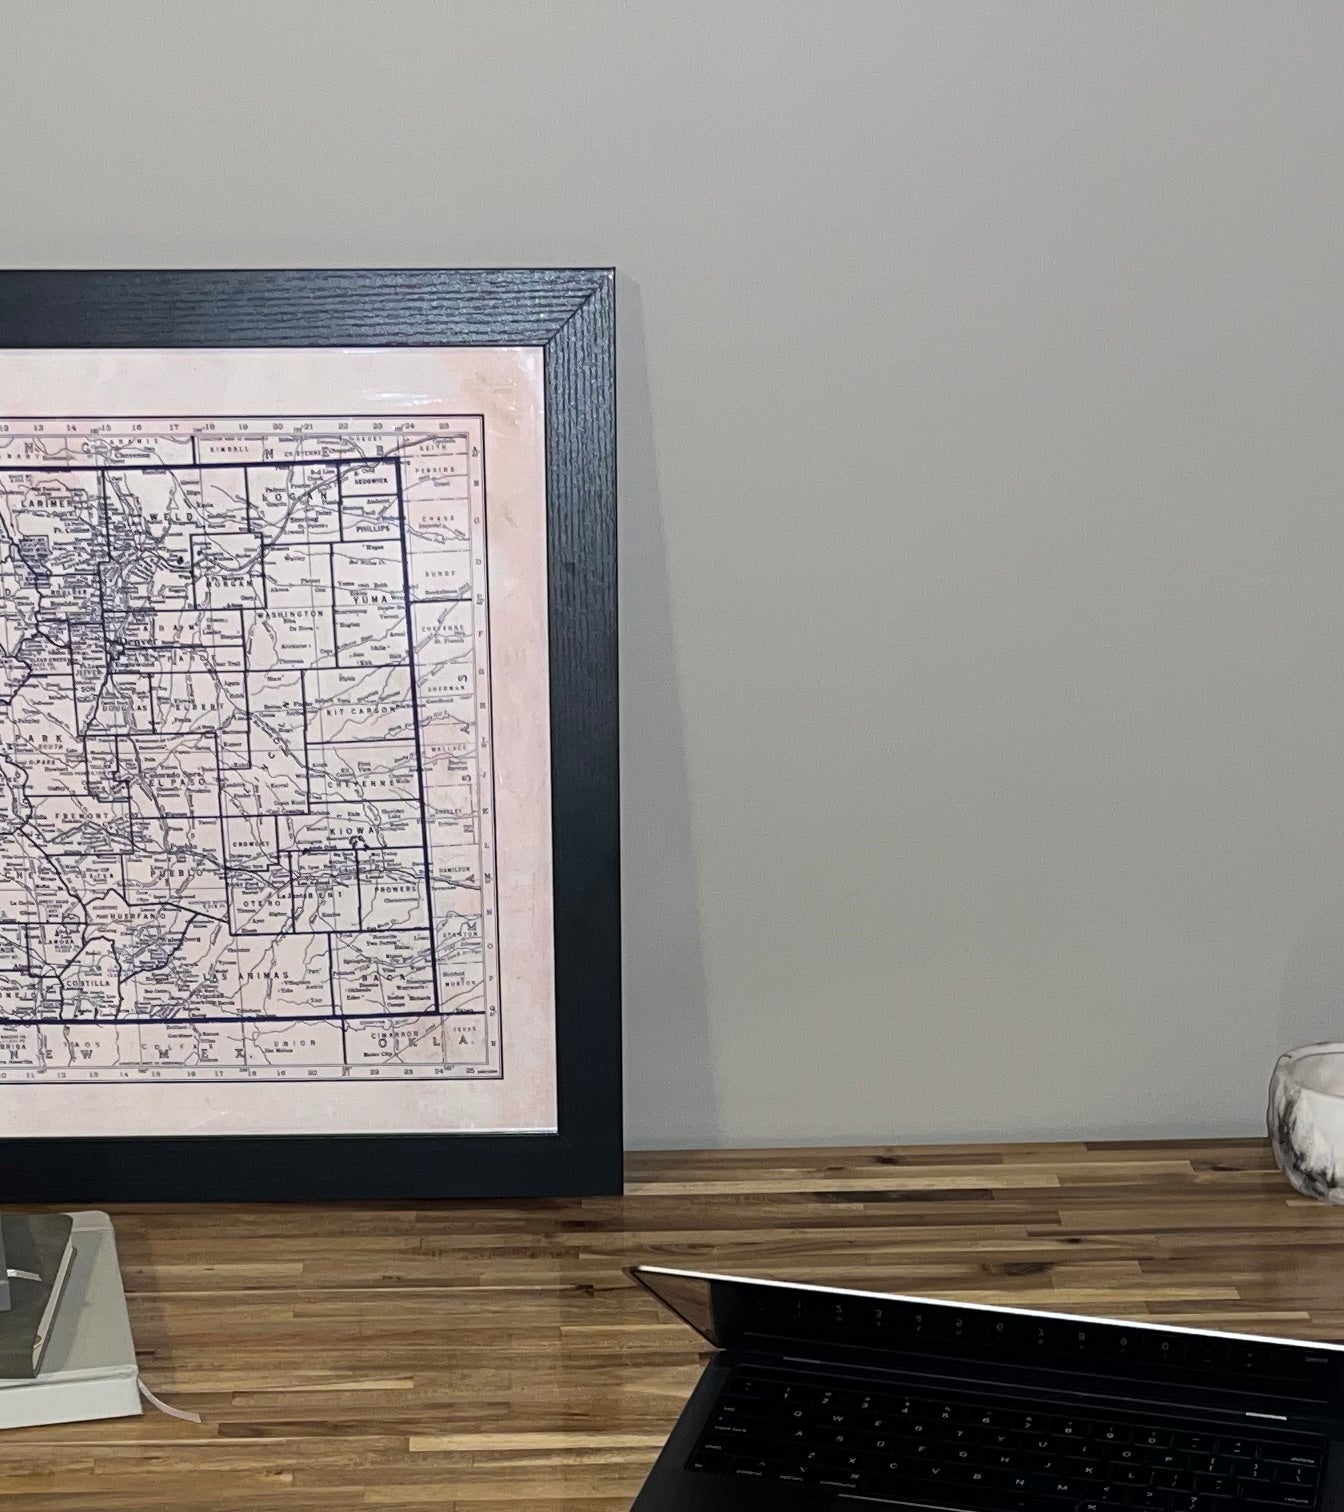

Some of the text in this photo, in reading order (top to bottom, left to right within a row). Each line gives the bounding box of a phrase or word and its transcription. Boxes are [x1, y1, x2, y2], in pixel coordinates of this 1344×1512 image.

[262, 492, 327, 501] LOGAN
[21, 500, 73, 508] LARIMER
[150, 513, 193, 521] WELD
[356, 525, 390, 533] PHILLIPS
[353, 595, 388, 604] YUMA
[257, 610, 324, 619] WASHINGTON
[176, 702, 224, 711] ELBERT
[326, 707, 395, 716] KIT CARSON
[15, 734, 63, 743] PARK
[327, 780, 395, 788] CHEYENNE
[330, 827, 375, 835] KIOWA
[150, 869, 203, 877] PUEBLO
[439, 866, 471, 874] HAMILTON
[243, 900, 281, 908] OTERO
[238, 971, 289, 980] ANIMAS
[362, 974, 406, 982] BACA
[371, 1031, 419, 1039] CIMARRON
[273, 1039, 316, 1047] UNION
